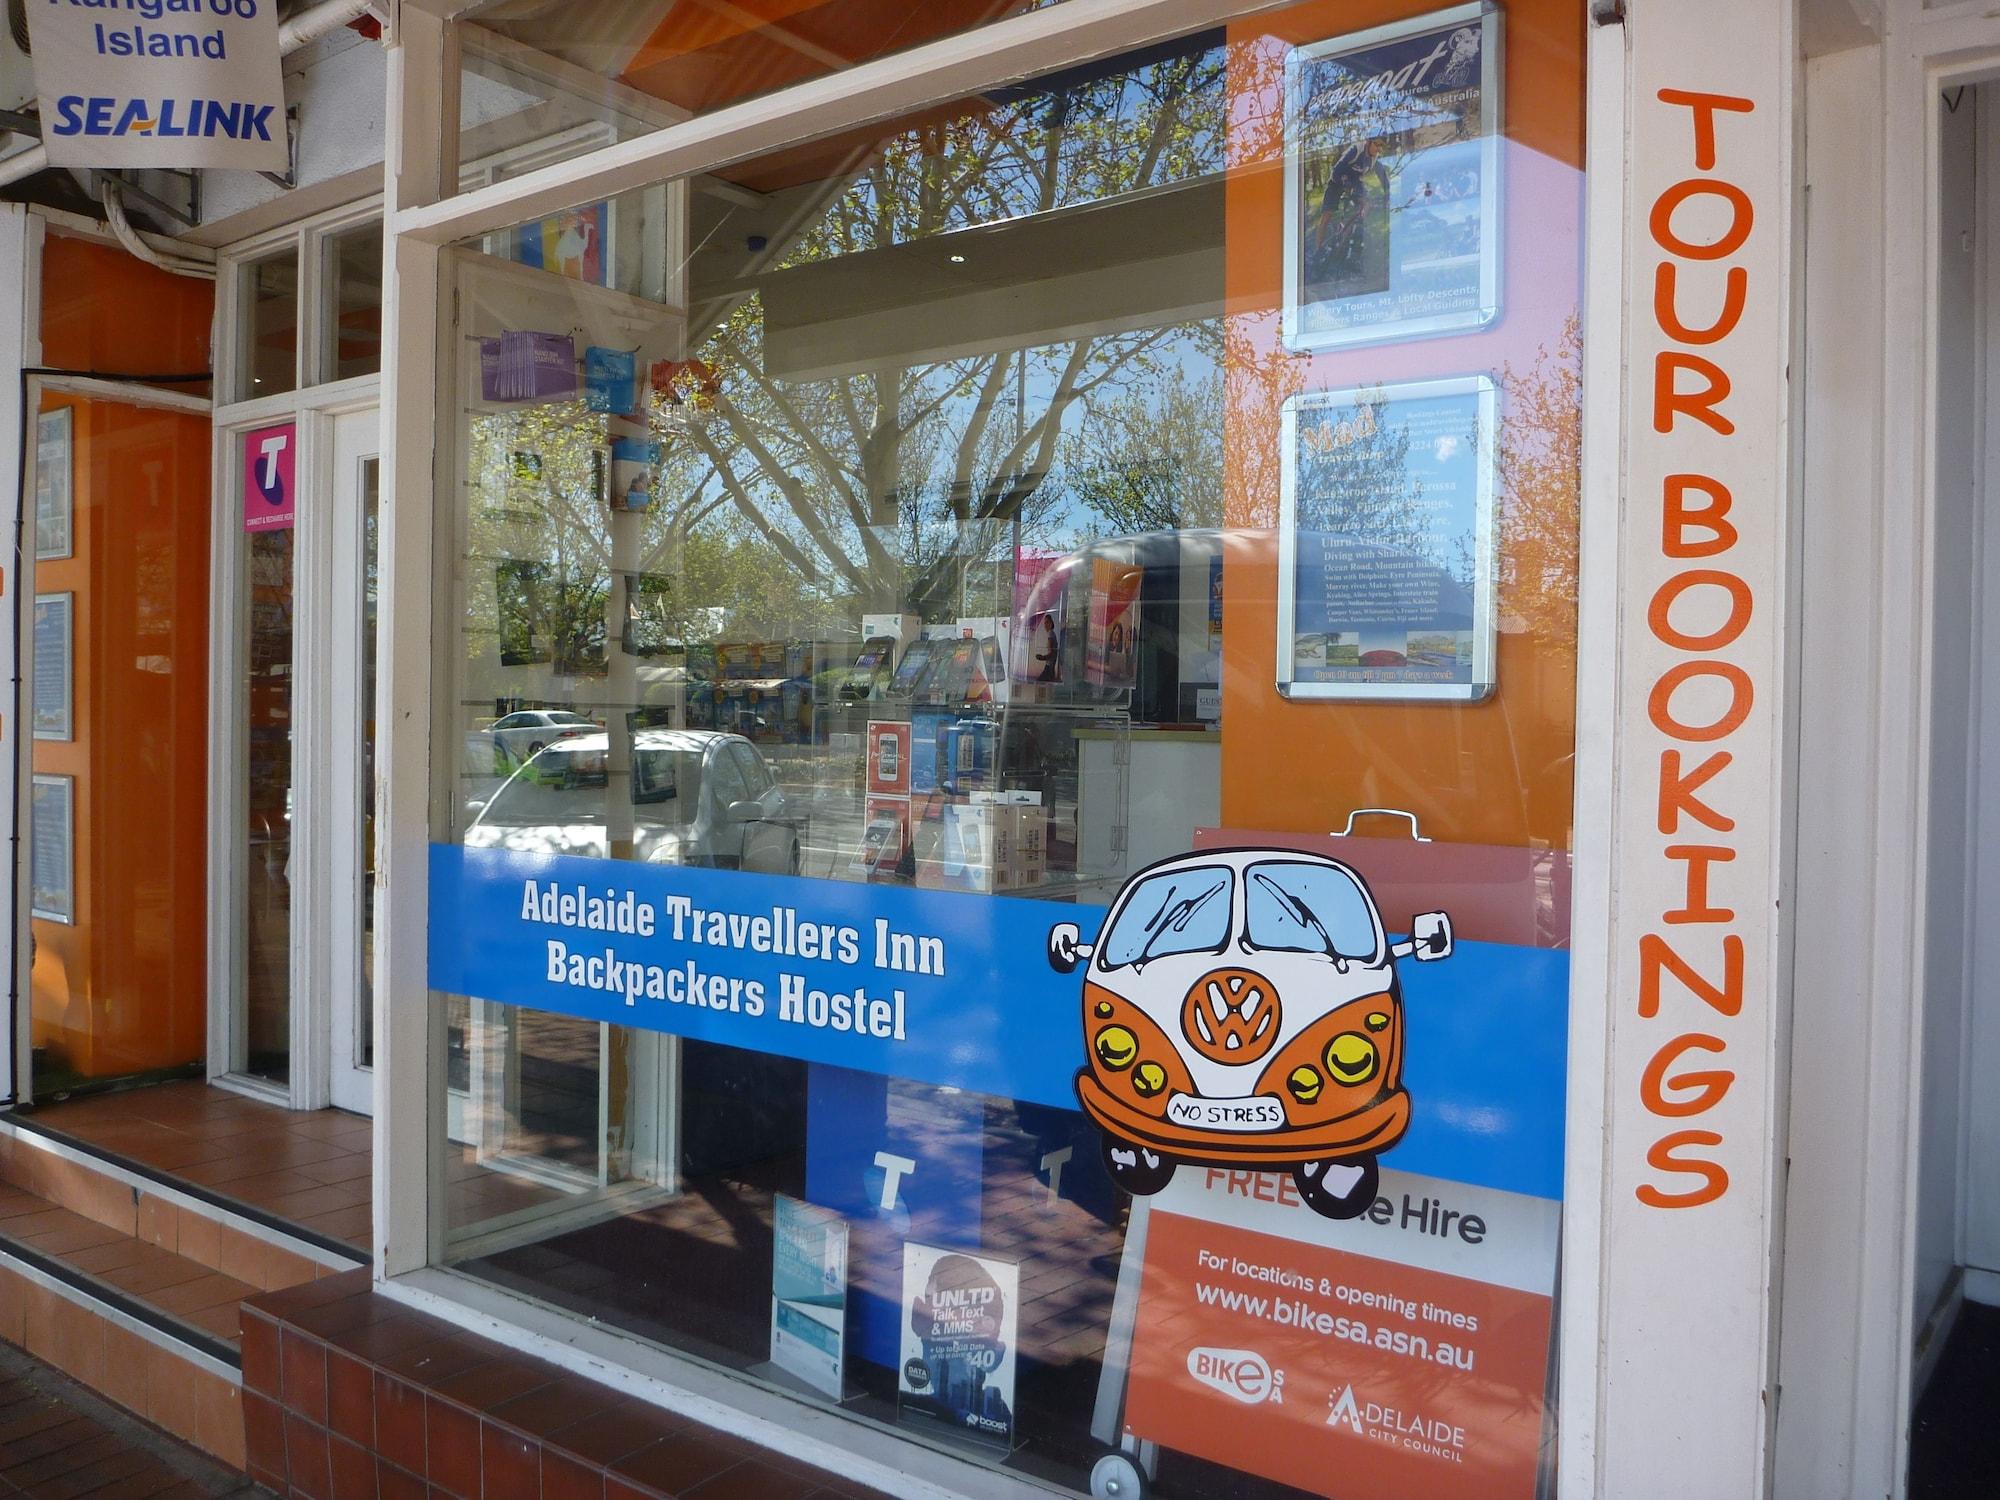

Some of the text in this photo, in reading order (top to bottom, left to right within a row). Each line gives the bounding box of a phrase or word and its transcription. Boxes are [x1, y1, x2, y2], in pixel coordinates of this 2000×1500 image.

[95, 24, 226, 60] Island
[1428, 88, 1481, 106] Australia
[53, 96, 276, 141] SEALINK
[1649, 88, 1755, 436] TOUR
[1398, 293, 1424, 306] Lofty
[1428, 286, 1480, 300] Descents,
[1404, 305, 1431, 316] Local
[1304, 404, 1377, 457] Mad
[261, 435, 287, 490] T
[1324, 551, 1353, 563] Diving
[1355, 550, 1376, 560] with
[1377, 548, 1414, 559] Sharks,
[1324, 563, 1349, 573] Ocean
[1350, 562, 1373, 572] Road,
[1375, 561, 1415, 571] Mountain
[1343, 573, 1358, 581] with
[1368, 581, 1387, 589] Make
[1635, 473, 1754, 1209] BOOKINGS
[521, 879, 945, 977] Adelaide Travellers Inn
[547, 940, 906, 1041] Backpackers Hostel
[1172, 1102, 1280, 1123] NO STRESS
[874, 1151, 916, 1210] T
[1205, 1168, 1299, 1208] FREE
[1400, 1194, 1487, 1245] Hire
[932, 1286, 996, 1308] UNLTD
[1198, 1249, 1478, 1331] For locations & opening times
[931, 1305, 985, 1322] Talk, Text
[931, 1320, 974, 1336] & MMS
[1196, 1282, 1475, 1371] www.bikesa.asn.au
[907, 1365, 928, 1378] DATA
[966, 1349, 996, 1369] $40
[979, 1416, 1009, 1432] boost
[1326, 1383, 1466, 1449] ADELAIDE
[1368, 1427, 1463, 1464] CITY COUNCIL
